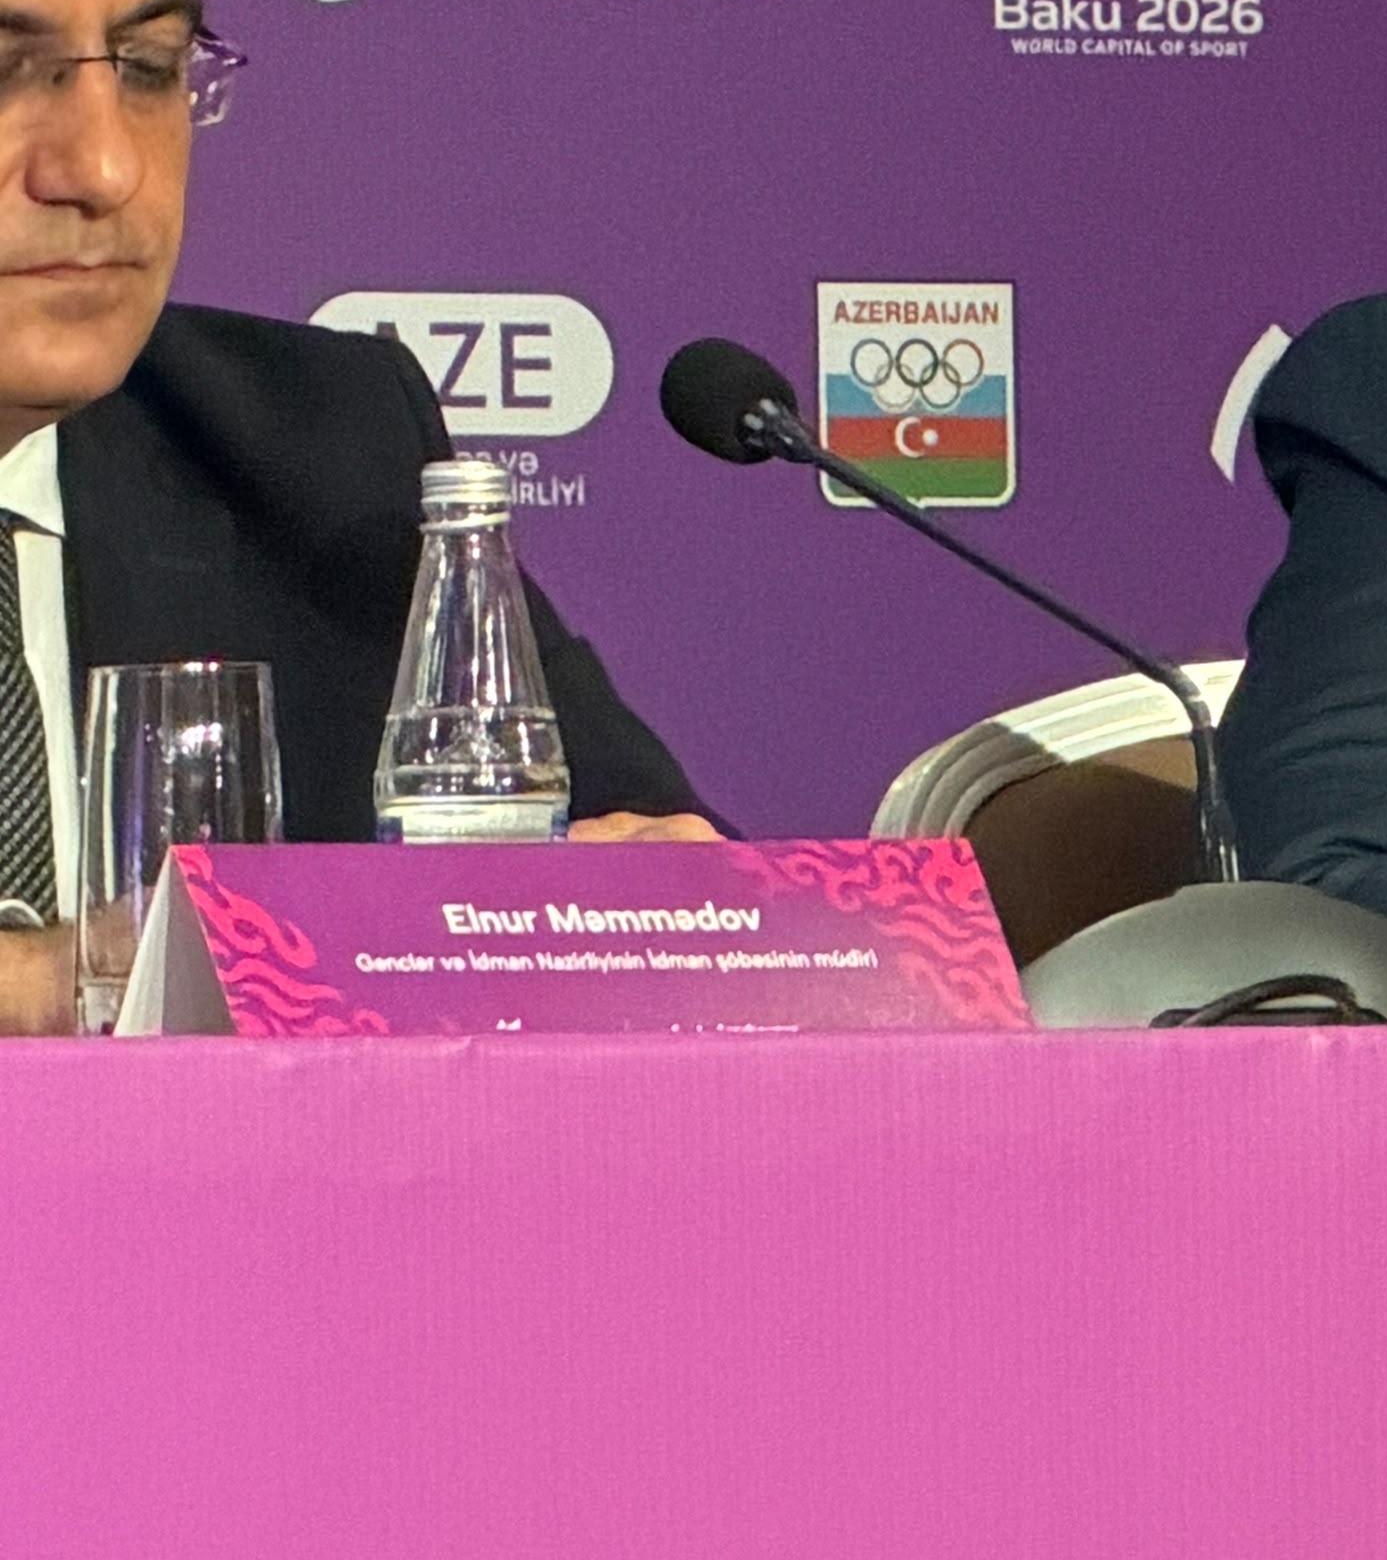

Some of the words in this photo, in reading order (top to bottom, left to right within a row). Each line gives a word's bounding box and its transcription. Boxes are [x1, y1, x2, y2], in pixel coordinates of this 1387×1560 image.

[1010, 38, 1077, 55] WORLD
[1081, 38, 1156, 56] CAPITAL
[1159, 39, 1185, 56] OF
[1189, 40, 1248, 59] SPORT
[833, 300, 999, 325] AZERBAIJAN
[376, 321, 553, 409] ZE
[441, 903, 537, 934] Elnur
[545, 900, 760, 934] Məmmədov
